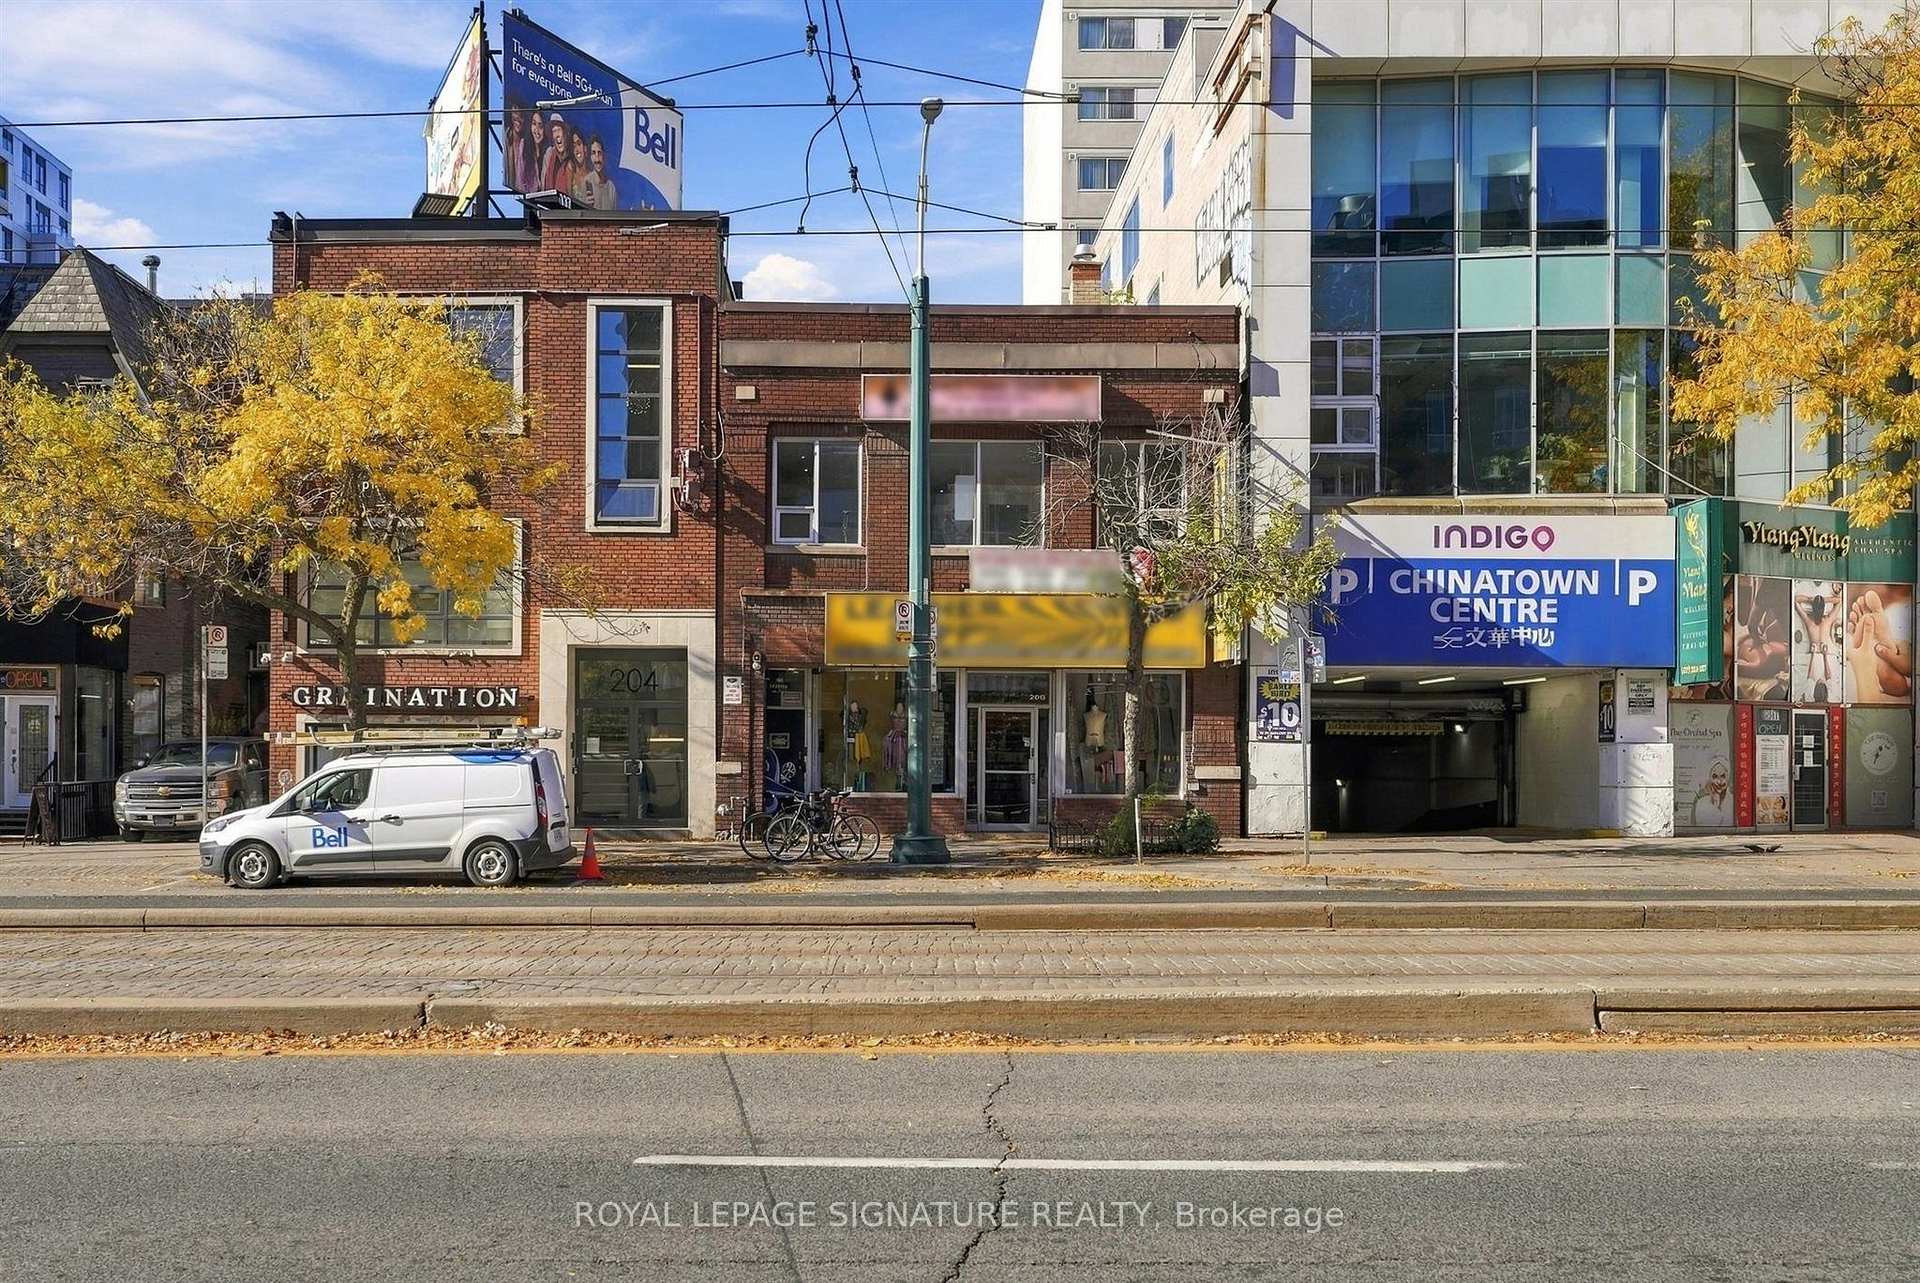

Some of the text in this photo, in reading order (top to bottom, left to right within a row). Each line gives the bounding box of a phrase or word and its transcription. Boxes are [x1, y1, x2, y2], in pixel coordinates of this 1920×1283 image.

[512, 38, 546, 70] There's
[548, 63, 555, 74] a
[557, 64, 573, 85] Bell
[575, 74, 592, 92] 5G+
[512, 57, 526, 76] for
[635, 105, 676, 170] Bell
[1433, 525, 1555, 552] INDIGO
[1744, 521, 1850, 557] Ylang-Ylang
[1331, 569, 1358, 604] P
[1389, 569, 1599, 595] CHINATOWN
[1628, 569, 1657, 606] P
[1430, 598, 1558, 623] CENTRE
[6, 671, 42, 688] OPEN
[610, 667, 659, 693] 204
[312, 826, 348, 848] Bell
